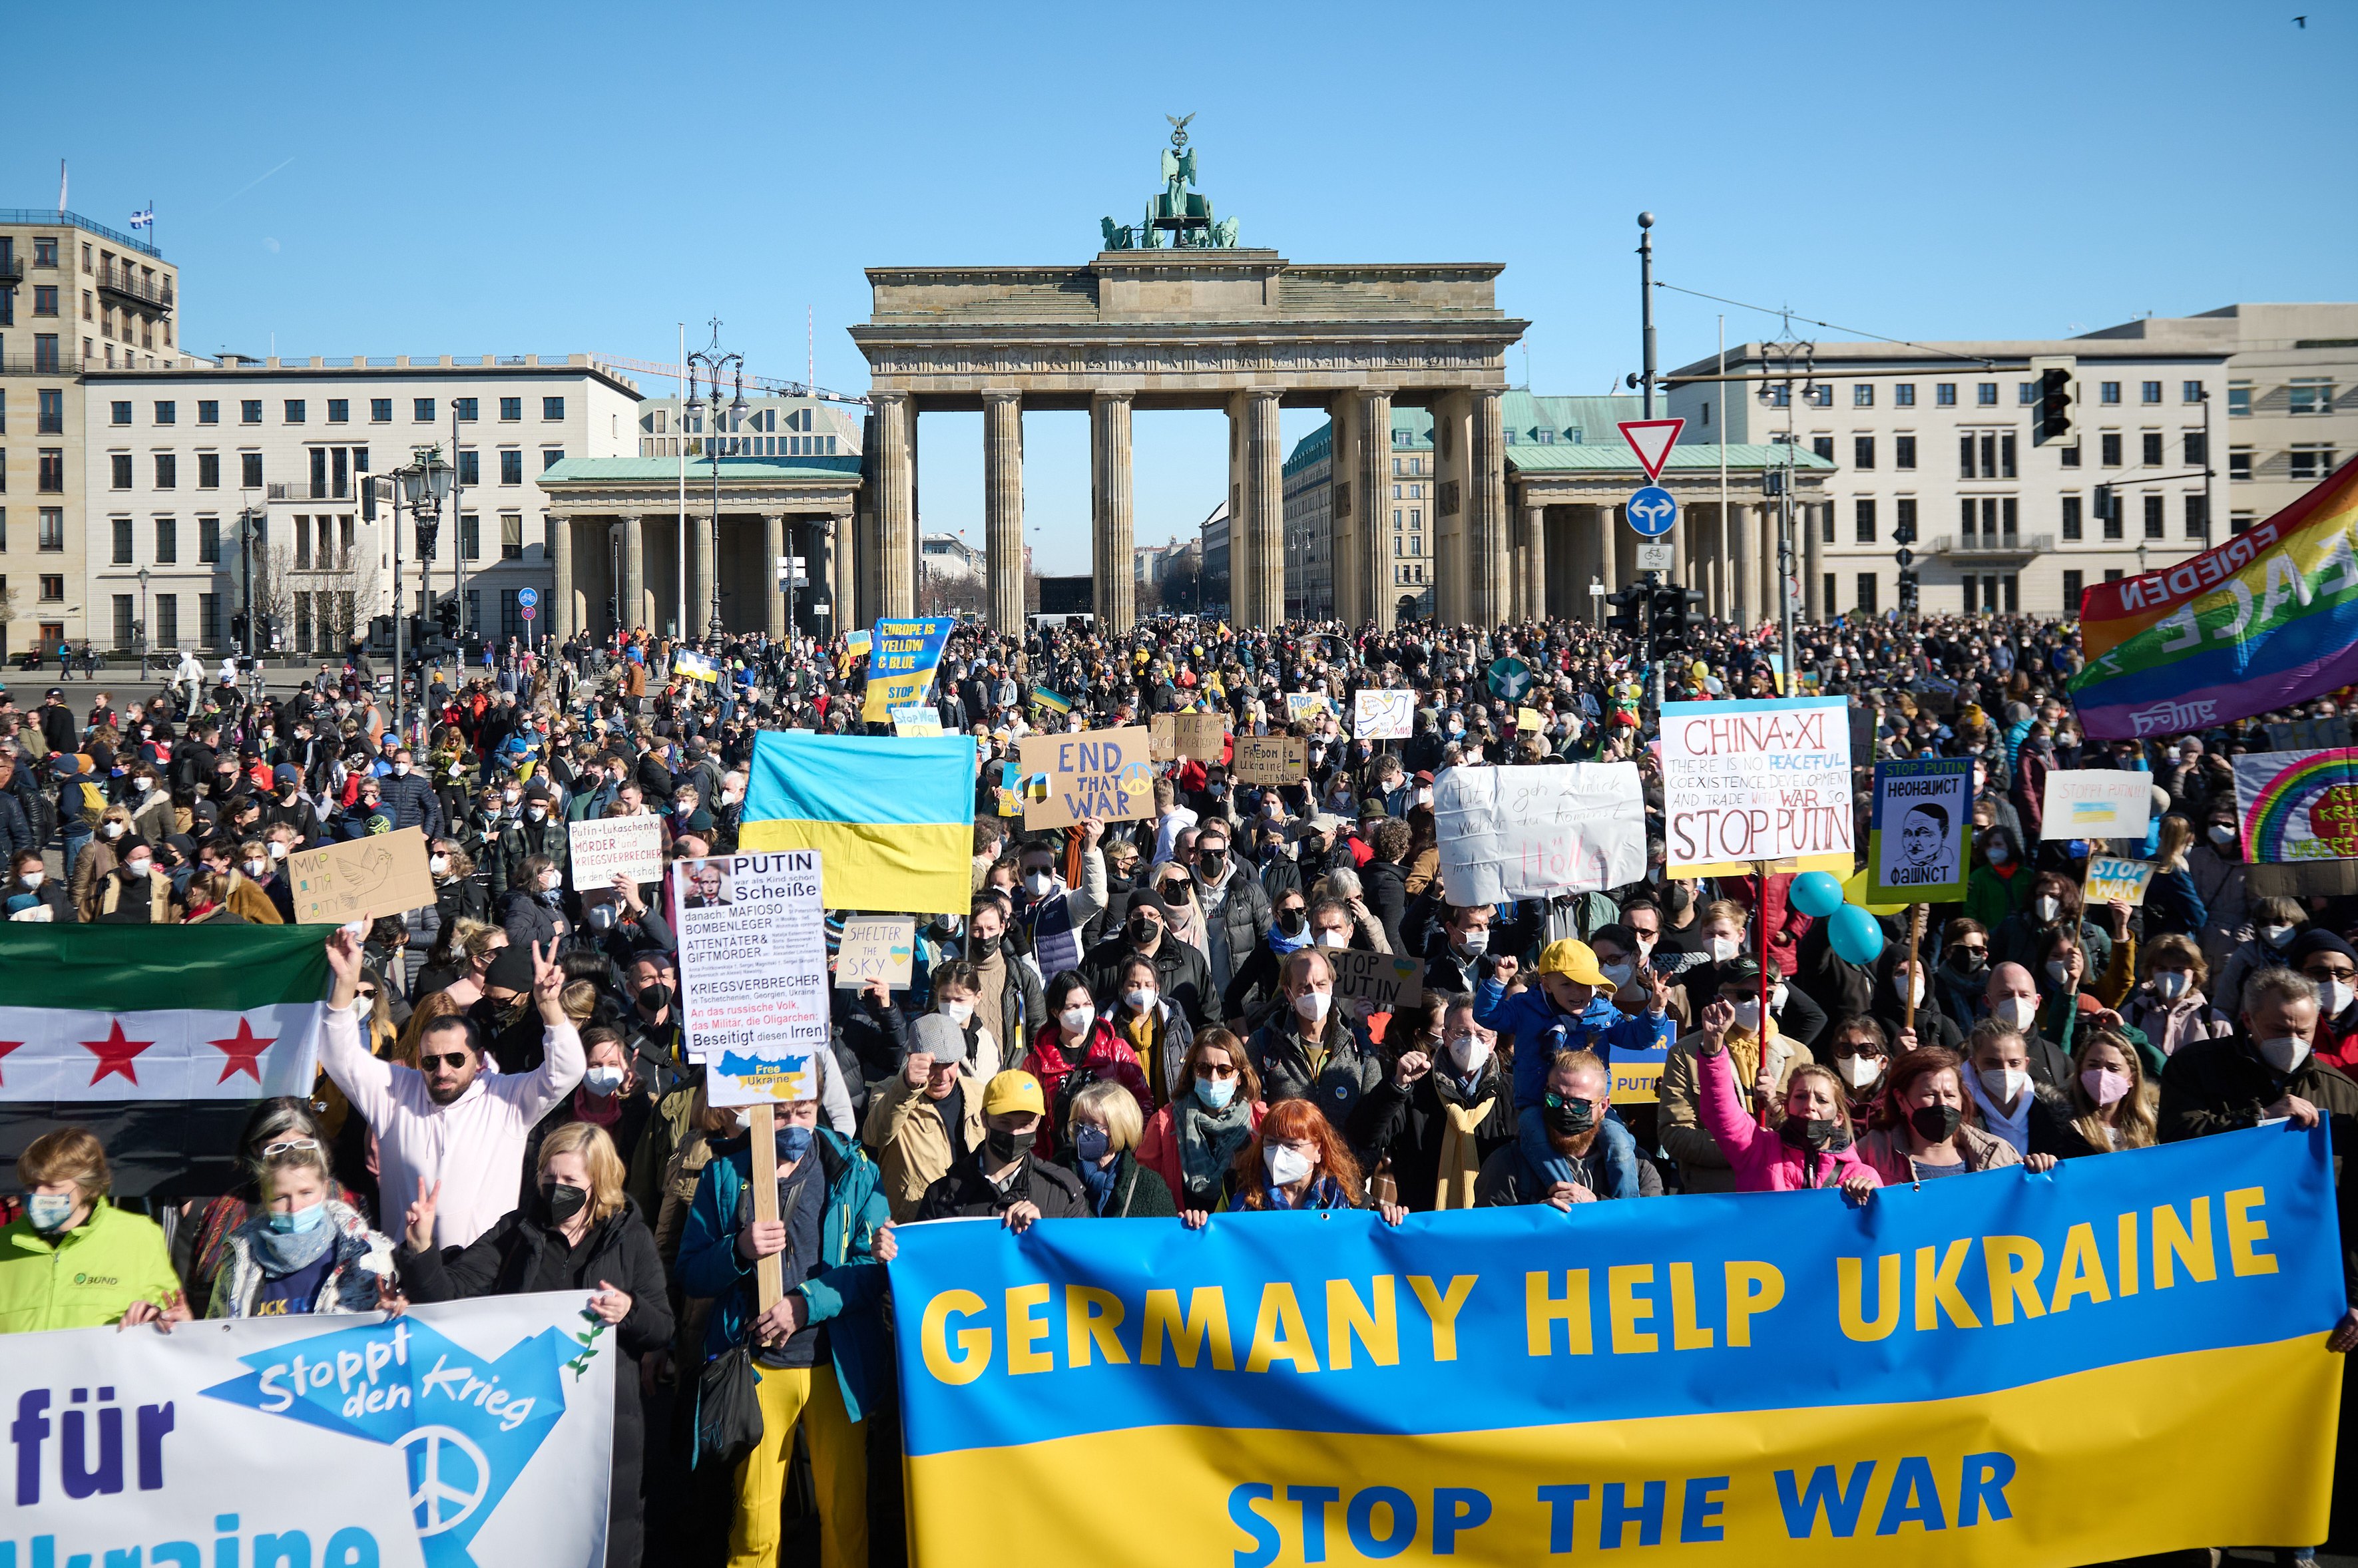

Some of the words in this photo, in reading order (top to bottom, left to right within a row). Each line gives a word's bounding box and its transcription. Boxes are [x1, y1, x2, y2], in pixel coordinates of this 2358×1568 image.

[882, 623, 923, 636] EUROPE
[924, 624, 935, 635] IS
[881, 639, 924, 652] YELLOW
[878, 656, 887, 669] &
[889, 656, 915, 669] BLUE
[888, 686, 914, 699] STOP
[1290, 696, 1311, 708] STOP
[1299, 703, 1323, 718] WAR
[893, 709, 917, 723] Stop
[918, 709, 938, 723] War
[1059, 742, 1122, 773] END
[1669, 759, 1718, 773] THERE
[1727, 757, 1737, 771] IS
[1744, 757, 1762, 771] NO
[1769, 753, 1845, 770] PEACEFUL
[1885, 763, 1919, 776] STOP
[1924, 761, 1967, 775] PUTIN
[1077, 775, 1120, 792] THAT
[1769, 771, 1849, 788] DEVELOPMENT
[1064, 790, 1130, 819] WAR
[1513, 779, 1548, 813] geh
[1672, 793, 1699, 808] AND
[1706, 793, 1745, 805] TRADE
[1752, 791, 1775, 805] WITH
[1827, 790, 1845, 803] SO
[572, 827, 597, 837] Putin
[1673, 809, 1769, 861] STOP
[1776, 803, 1851, 854] PUTIN
[575, 839, 616, 853] MÖRDER
[621, 838, 637, 849] und
[2287, 837, 2357, 858] UNSERE
[294, 853, 328, 877] МИР
[575, 849, 662, 867] KRIEGSVERBRECHER
[734, 853, 812, 875] PUTIN
[589, 871, 603, 881] den
[2094, 859, 2147, 877] STOP
[300, 873, 332, 897] ДЛЯ
[736, 882, 817, 900] Scheiße
[2096, 877, 2138, 898] WAR
[299, 896, 340, 921] СВІТУ
[685, 910, 725, 922] danach:
[729, 903, 783, 918] MAFIOSO
[686, 918, 772, 935] BOMBENLEGER
[847, 926, 901, 941] SHELTER
[687, 933, 758, 951] ATTENTÄTER
[761, 934, 768, 944] &
[863, 946, 877, 956] THE
[688, 946, 761, 963] GIFTMÖRDER
[1327, 951, 1379, 974] STOP
[847, 958, 885, 976] SKY
[690, 974, 820, 995] KRIEGSVERBRECHER
[754, 990, 787, 1001] Georgien,
[788, 988, 816, 997] Ukraine
[690, 1008, 703, 1018] An
[707, 1007, 724, 1016] das
[728, 1003, 773, 1015] russische
[776, 1000, 800, 1010] Volk,
[692, 1021, 709, 1030] das
[711, 1018, 744, 1030] Militär,
[746, 1016, 760, 1026] die
[764, 1012, 818, 1026] Oligarchen:
[692, 1030, 754, 1047] Beseitigt
[757, 1031, 788, 1042] diesen
[791, 1023, 827, 1039] Irren!
[756, 1065, 781, 1074] Free
[748, 1075, 790, 1085] Ukraine
[1618, 1078, 1655, 1091] PUTI
[87, 1276, 118, 1285] BUND
[921, 1274, 1479, 1385] GERMANY
[1526, 1261, 1786, 1357] HELP
[1837, 1186, 2280, 1342] UKRAINE
[258, 1323, 412, 1413] Stoppt
[342, 1381, 411, 1418] den
[422, 1354, 536, 1432] Krieg
[11, 1386, 174, 1507] für
[1228, 1481, 1493, 1568] STOP
[1538, 1475, 1730, 1555] THE
[1773, 1451, 2016, 1540] WAR
